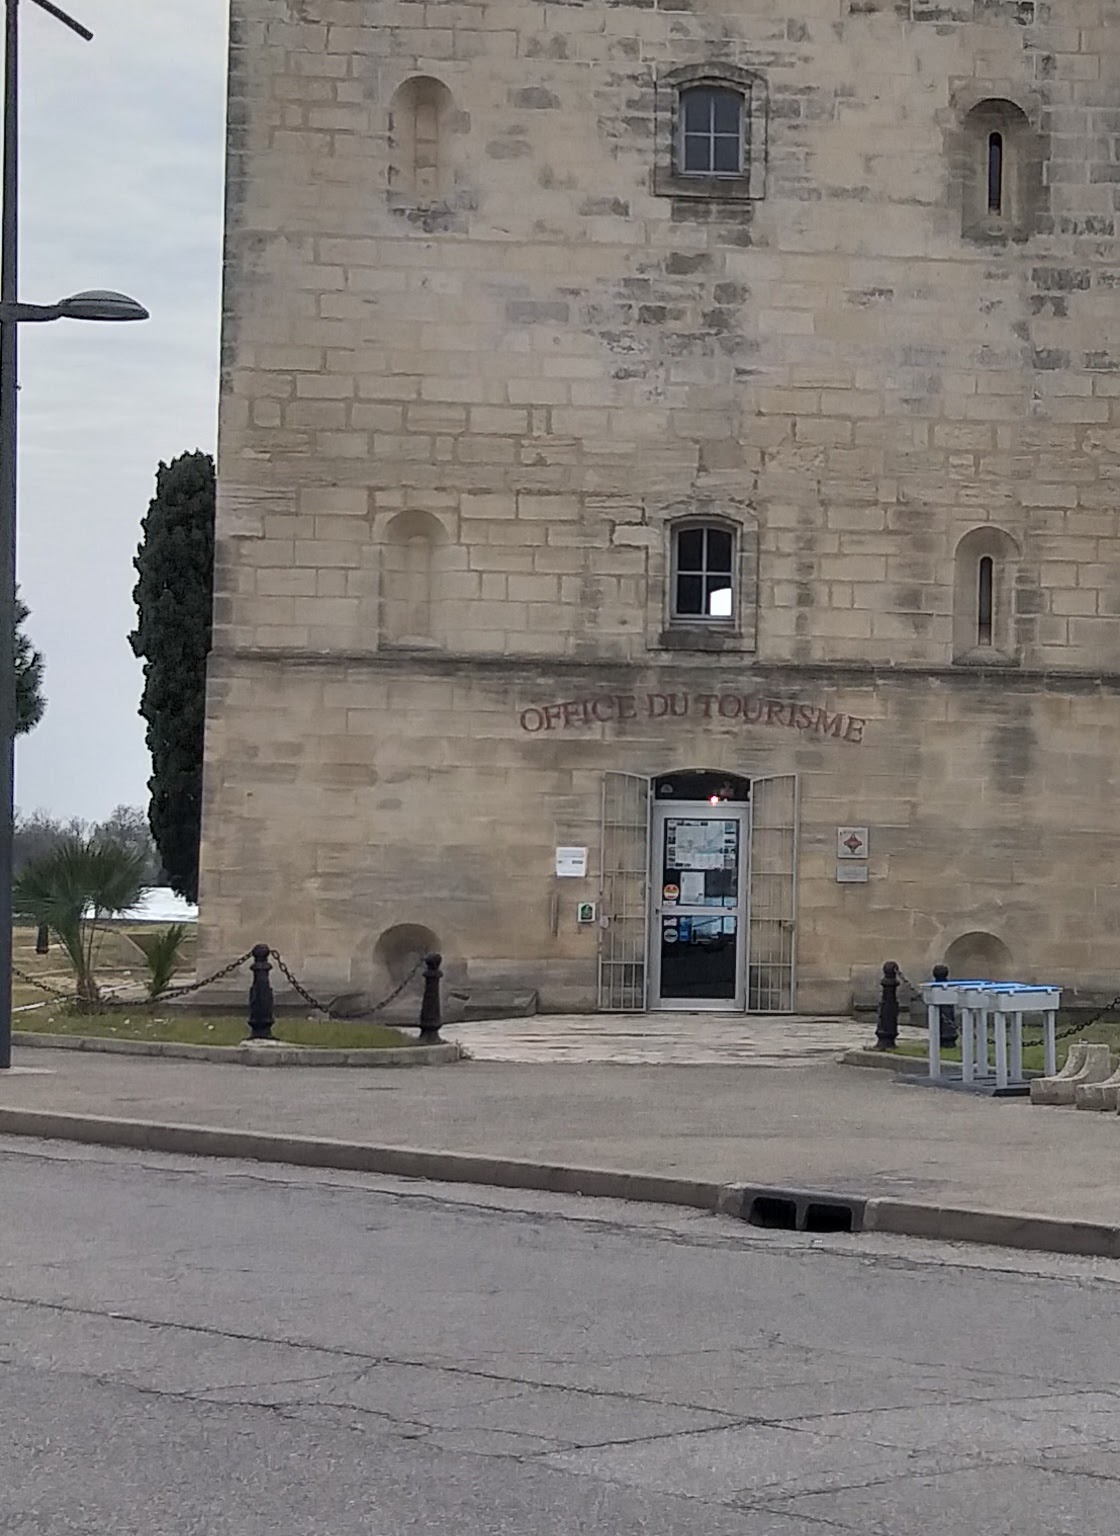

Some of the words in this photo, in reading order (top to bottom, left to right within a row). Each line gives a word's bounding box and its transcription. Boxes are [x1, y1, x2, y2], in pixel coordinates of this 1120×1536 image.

[520, 694, 636, 732] OFFICE
[646, 692, 689, 718] DU
[701, 693, 866, 744] TOURISME
